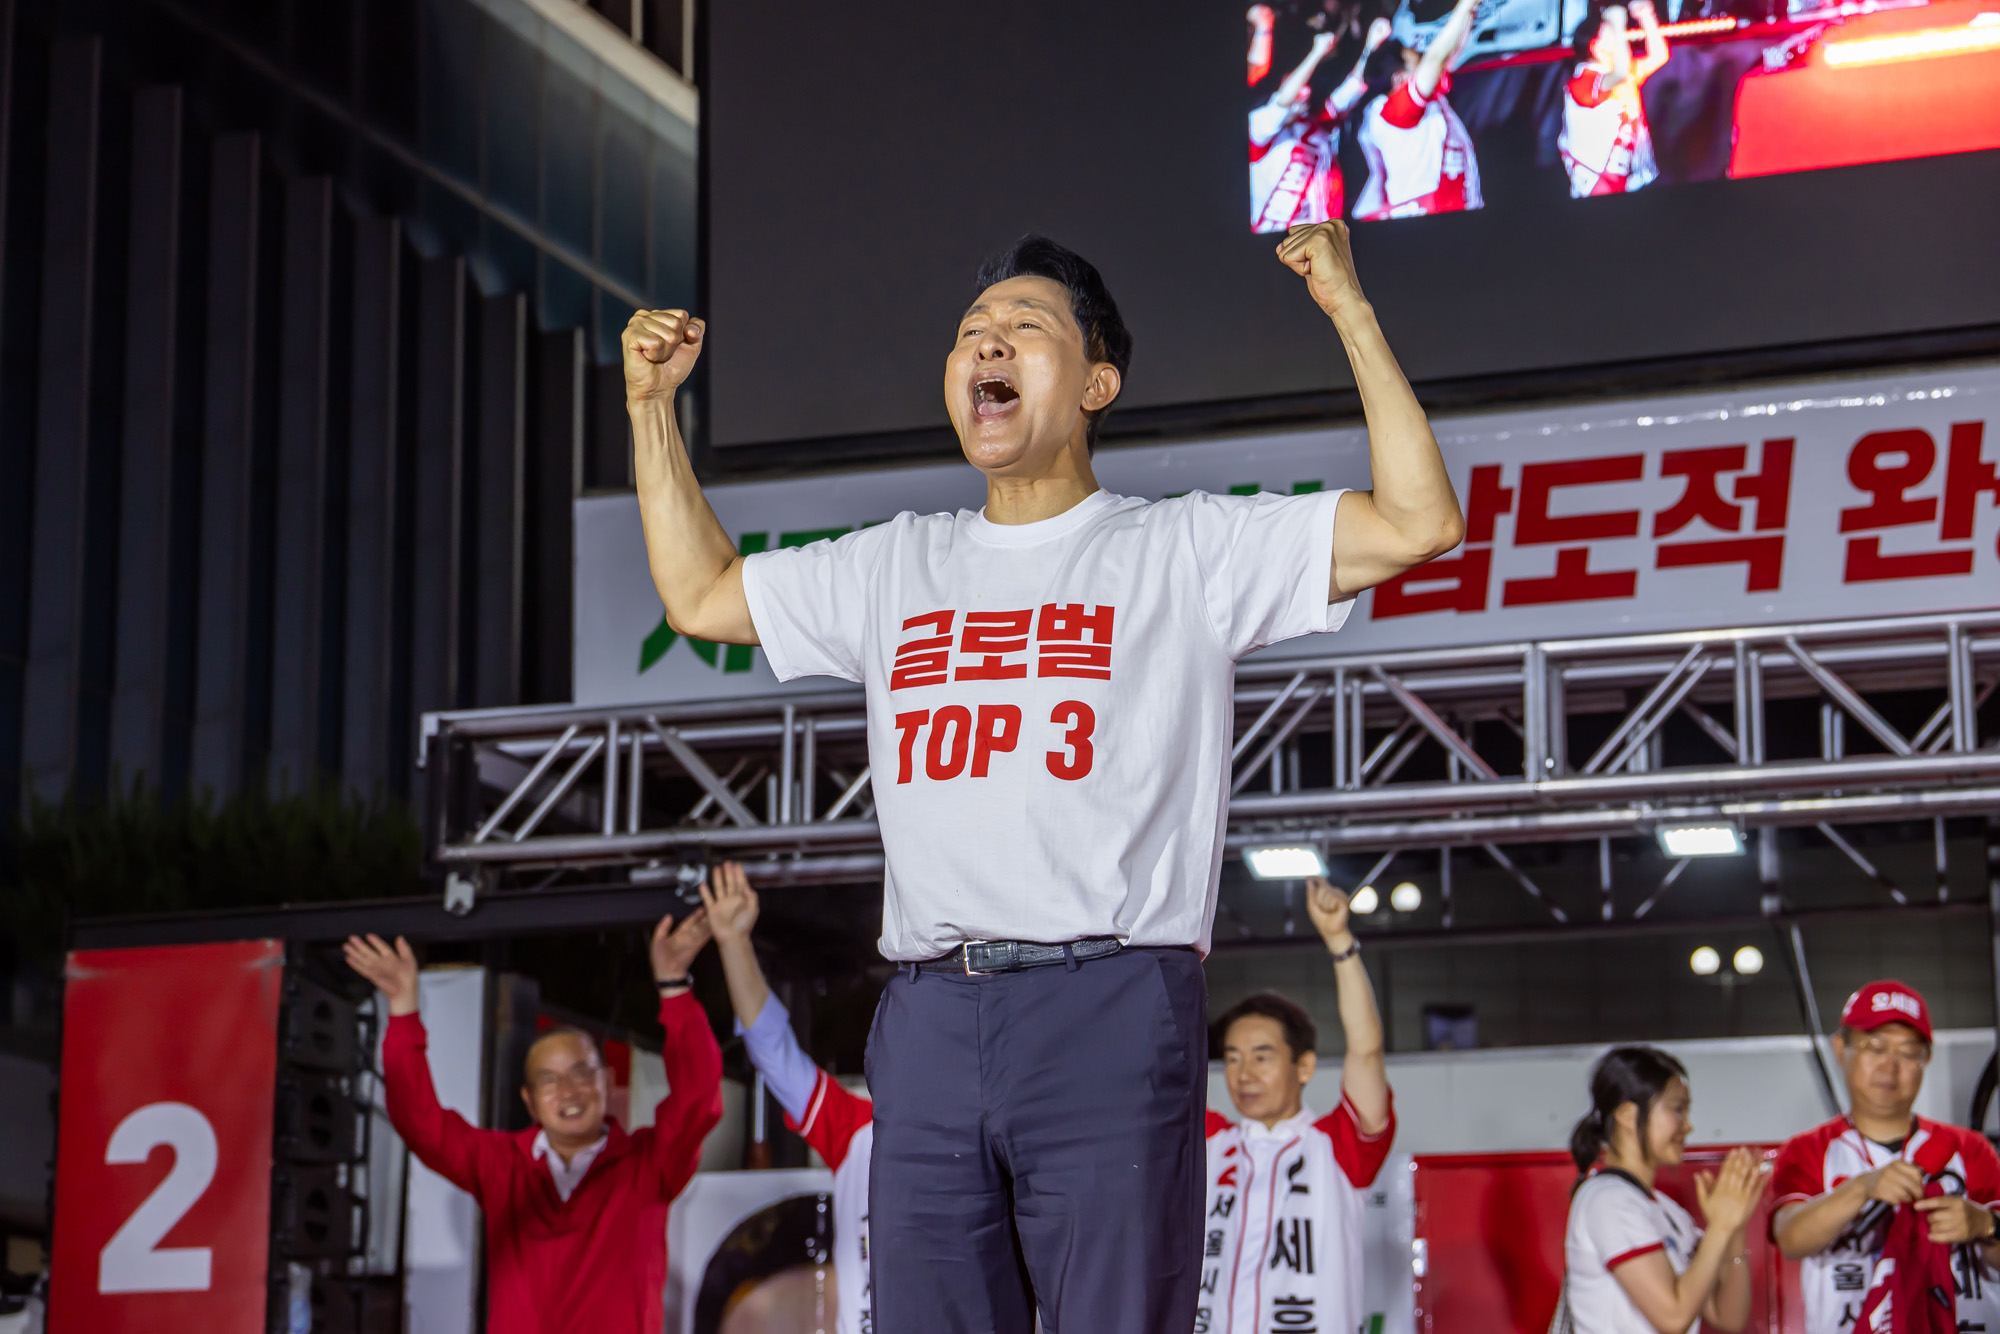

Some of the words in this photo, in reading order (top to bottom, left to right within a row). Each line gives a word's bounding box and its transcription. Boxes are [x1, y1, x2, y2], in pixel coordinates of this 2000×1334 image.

[1839, 420, 2000, 585] 완
[891, 603, 1115, 691] 글로벌
[895, 704, 1022, 784] TOP
[1046, 700, 1096, 780] 3
[98, 1102, 218, 1294] 2
